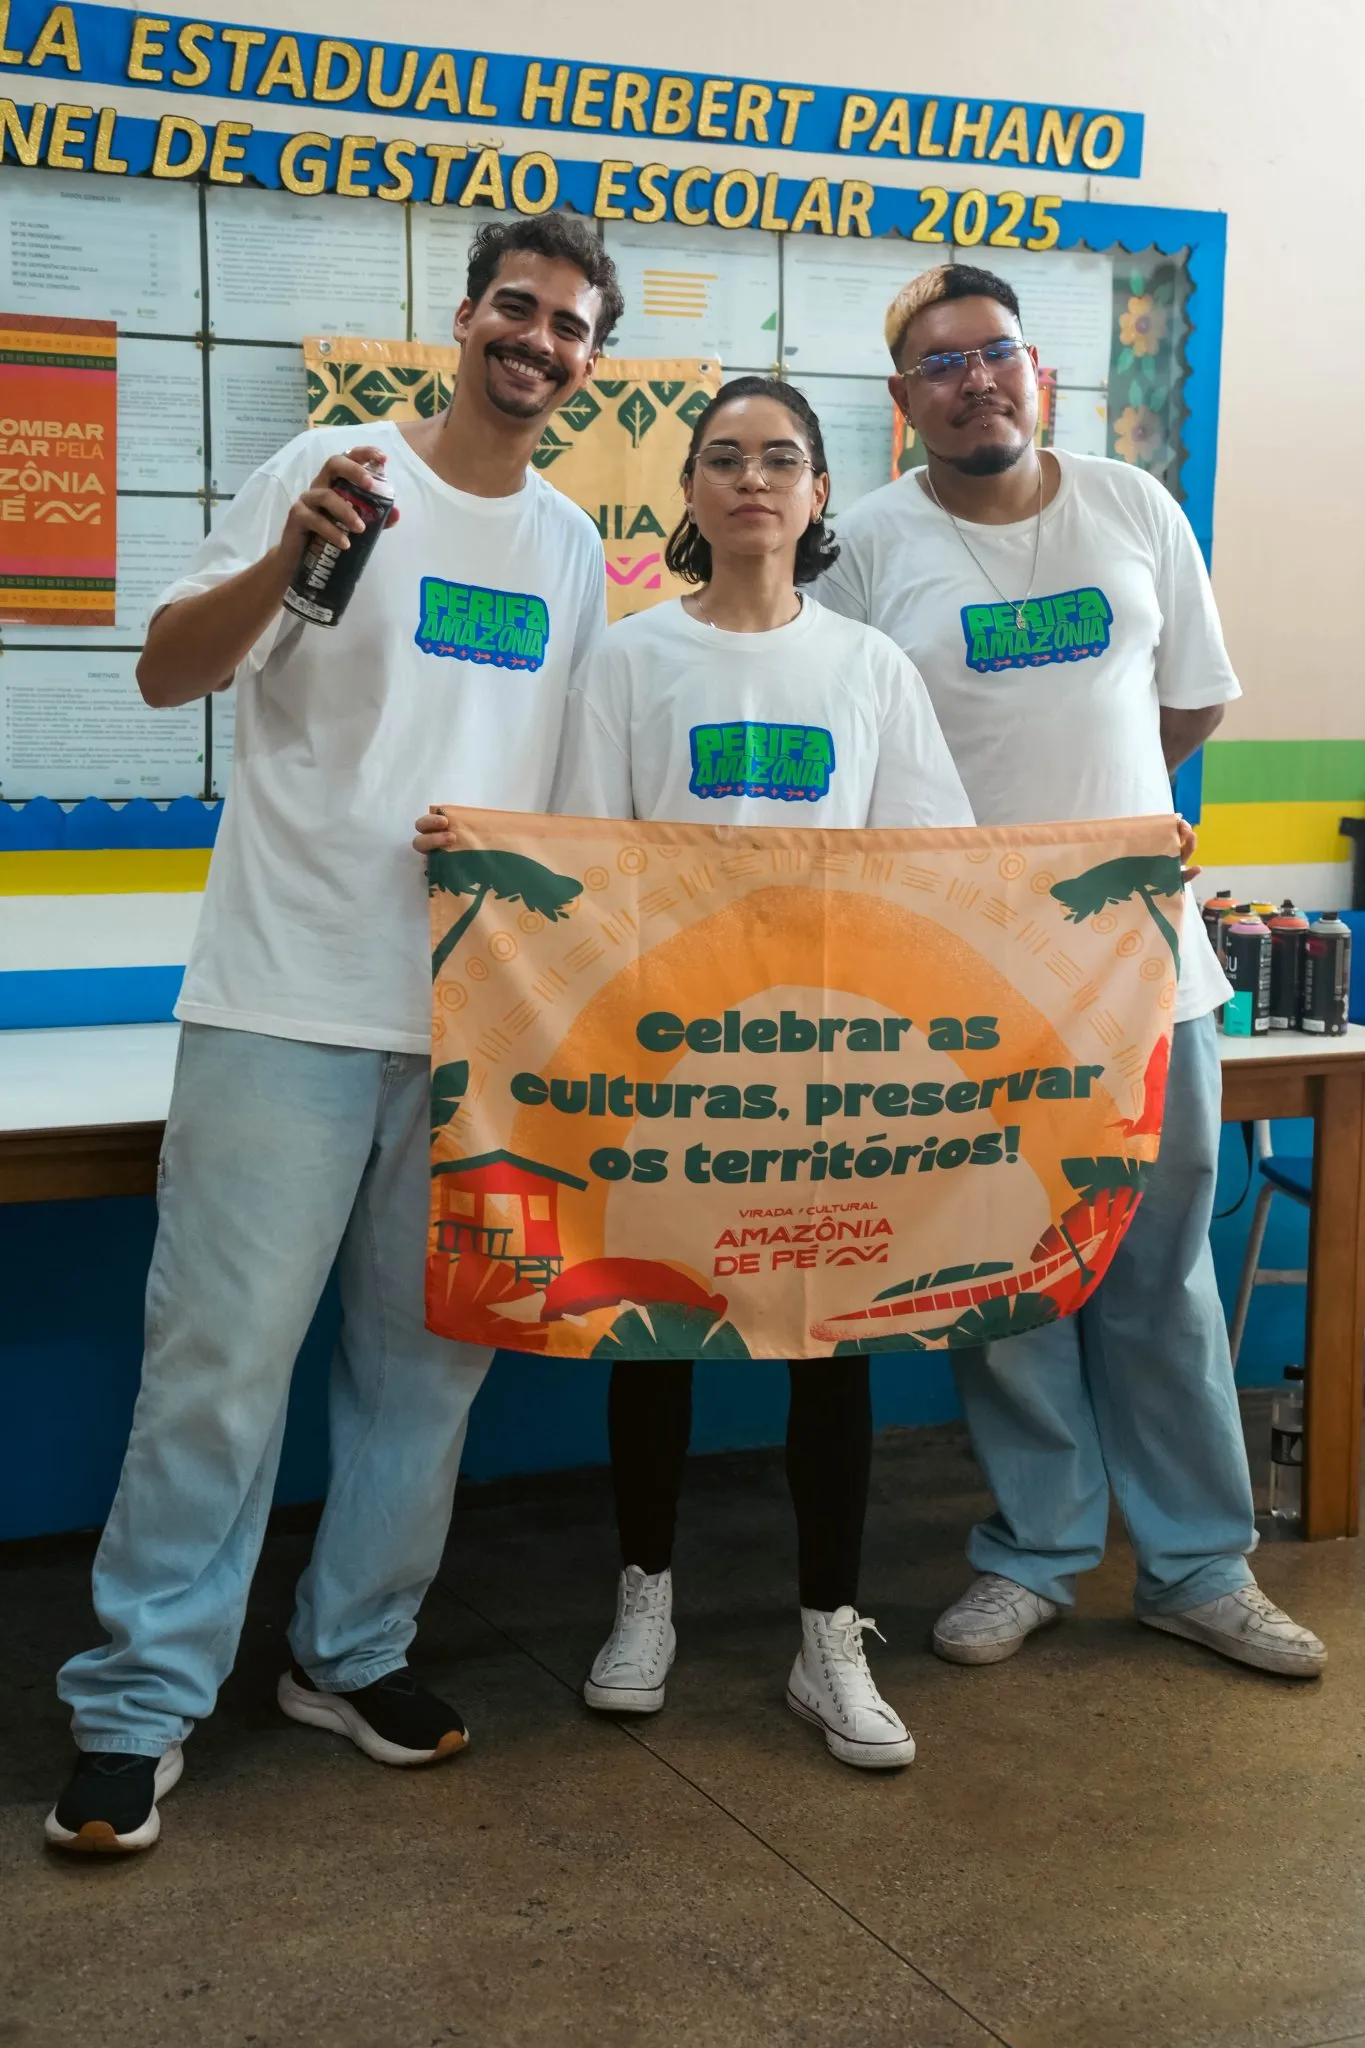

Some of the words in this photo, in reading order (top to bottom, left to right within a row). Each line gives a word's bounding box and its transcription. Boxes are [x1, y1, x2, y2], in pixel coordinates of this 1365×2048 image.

[0, 0, 81, 72] LA
[127, 17, 498, 118] ESTADUAL
[520, 62, 815, 146] HERBERT
[838, 94, 1125, 171] PALHANO
[0, 97, 129, 174] NEL
[152, 114, 253, 185] DE
[280, 131, 560, 216] GESTÃO
[593, 159, 875, 238] ESCOLAR
[911, 185, 1063, 251] 2025
[0, 418, 104, 441] OMBAR
[55, 441, 105, 460] PELA
[0, 460, 106, 496] ZÔNIA
[696, 752, 826, 789] AMAZÔNIA
[635, 1010, 913, 1054] Celebrar
[927, 1015, 1001, 1051] as
[510, 1071, 791, 1122] culturas,
[805, 1064, 1106, 1126] preservar
[589, 1146, 669, 1184] os
[684, 1125, 1021, 1185] territórios!
[738, 1207, 794, 1219] VIRADA
[805, 1200, 879, 1216] CULTURAL
[713, 1215, 895, 1250] AMAZÔNIA
[713, 1252, 761, 1278] DE
[771, 1243, 820, 1271] PÉ
